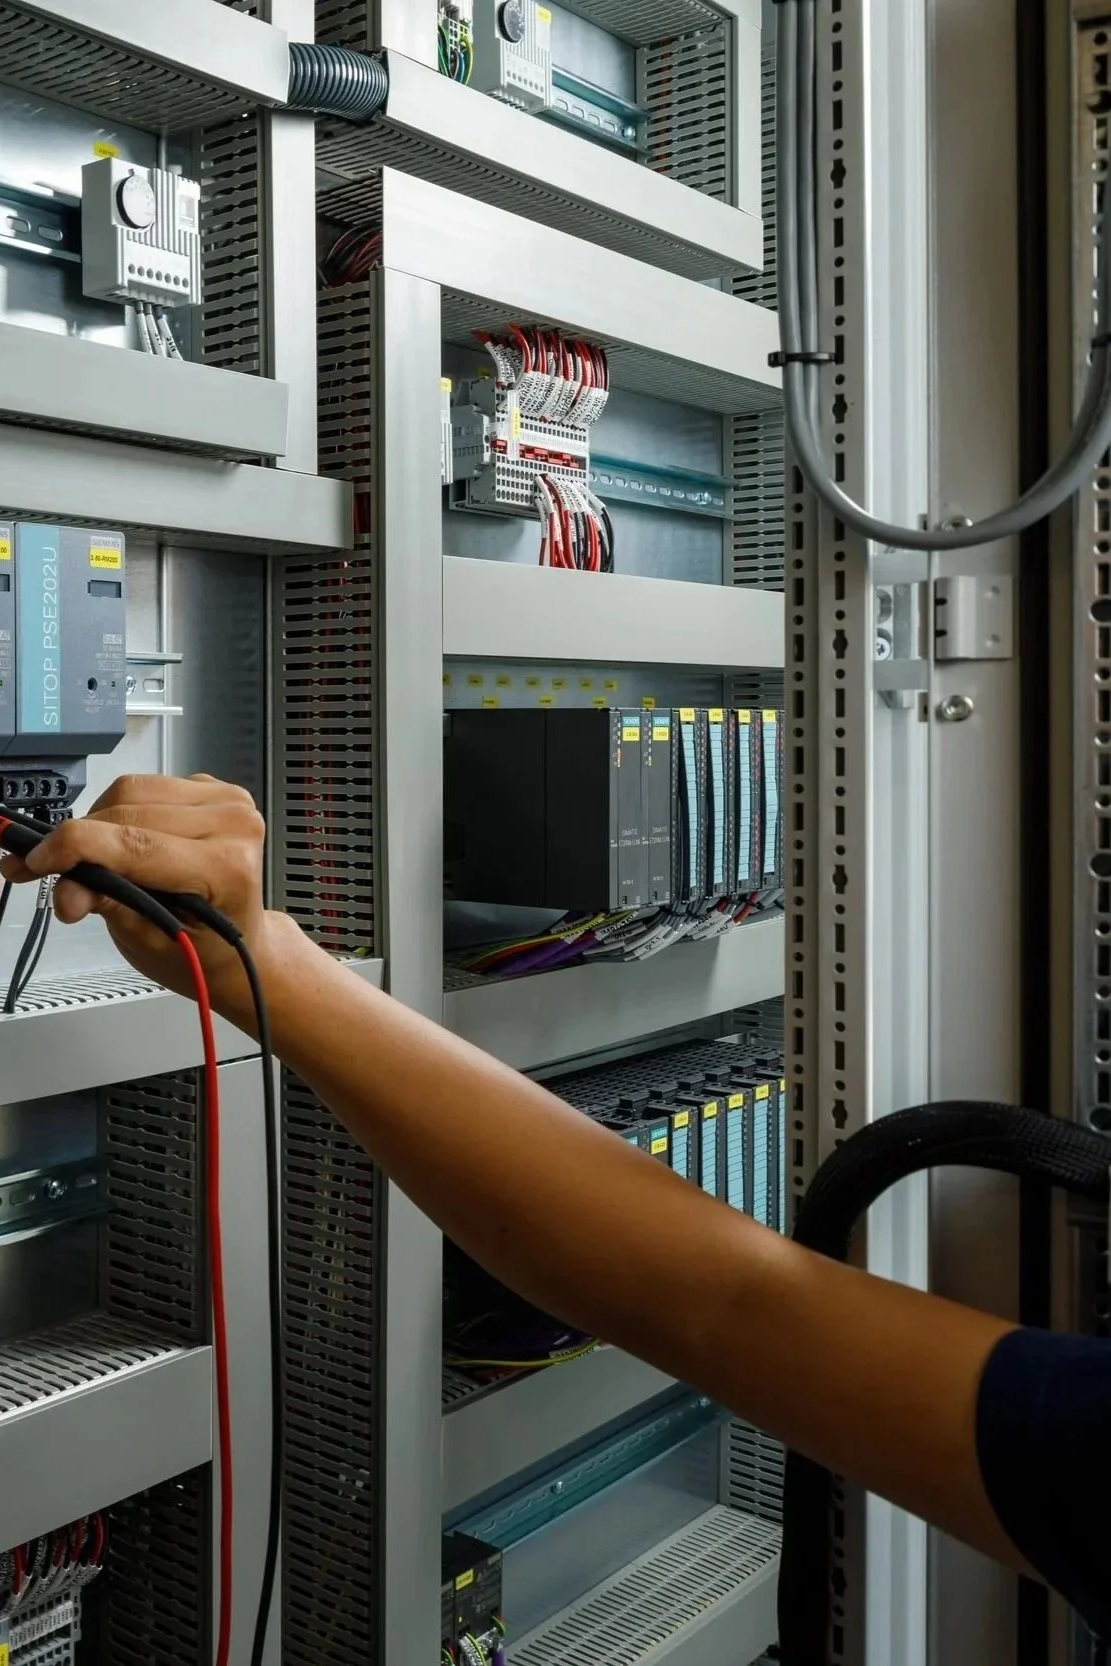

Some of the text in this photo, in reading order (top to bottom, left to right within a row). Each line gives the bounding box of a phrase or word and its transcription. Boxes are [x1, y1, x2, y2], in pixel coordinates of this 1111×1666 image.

[90, 554, 119, 564] 2-50-RM200
[43, 547, 58, 726] SITOP PSE202U
